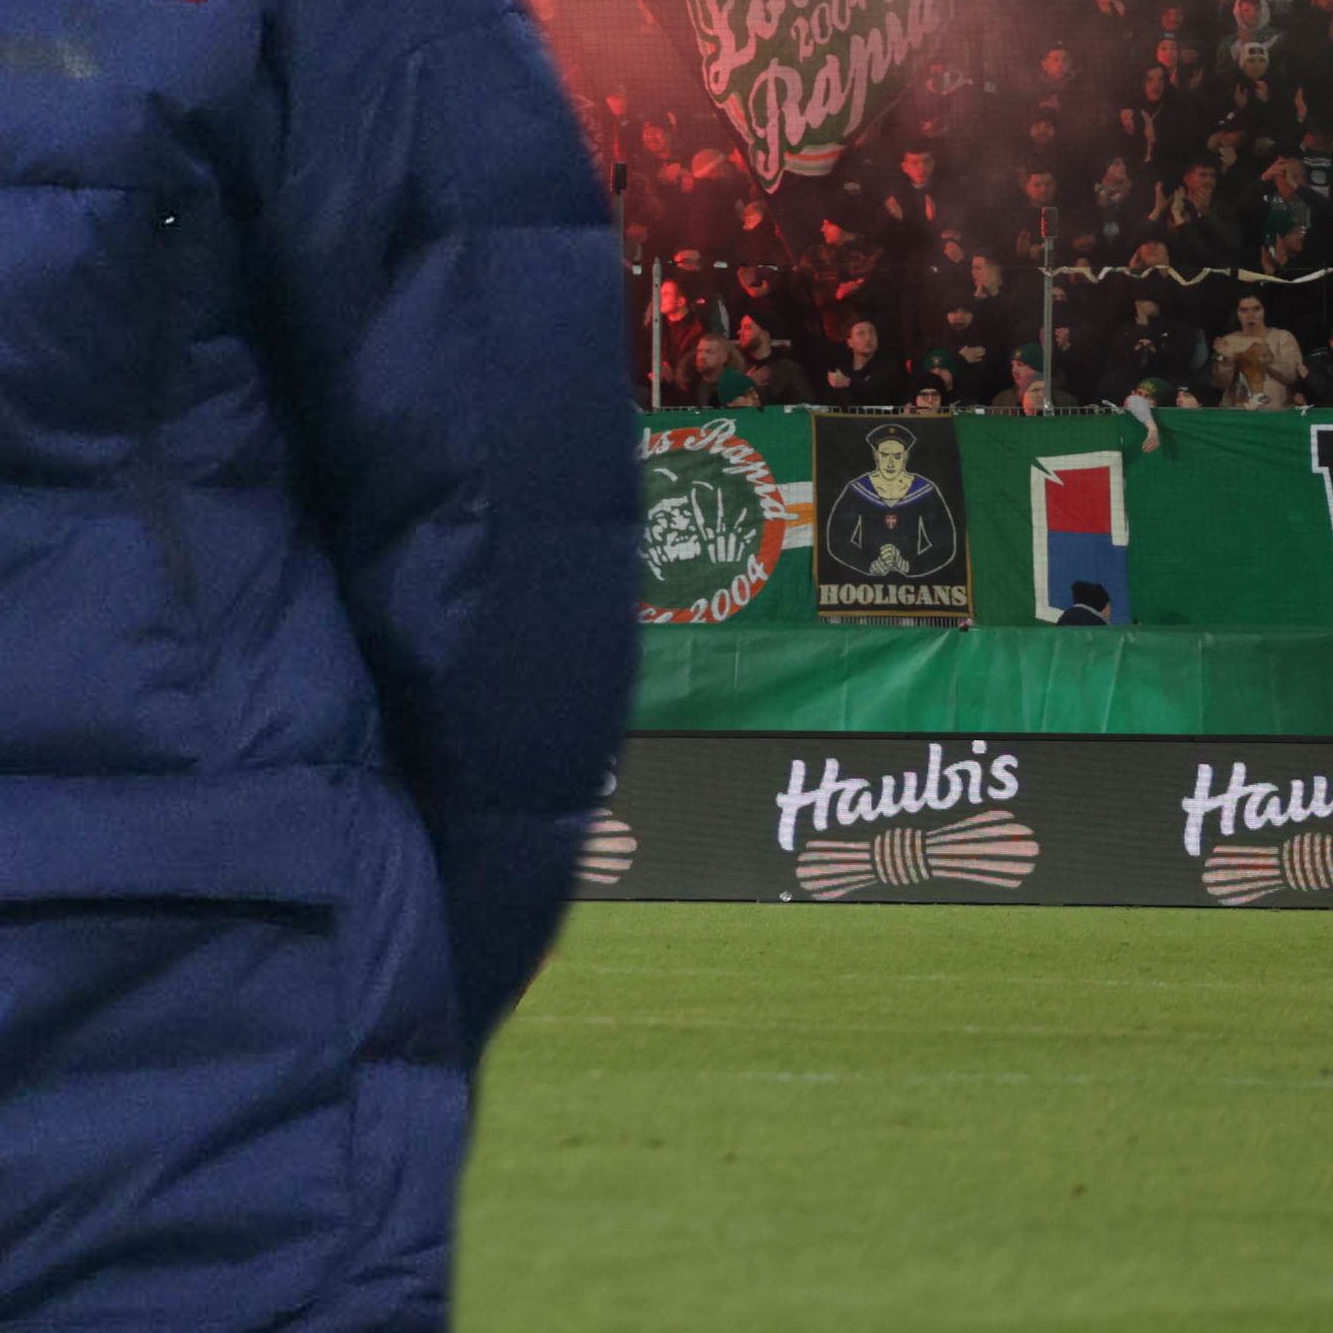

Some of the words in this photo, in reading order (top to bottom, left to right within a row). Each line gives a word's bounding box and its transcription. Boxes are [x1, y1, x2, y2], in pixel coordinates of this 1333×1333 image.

[683, 417, 800, 521] Rapid
[689, 553, 769, 624] 2004
[818, 583, 968, 608] HOOLIGANS
[776, 740, 1019, 851] Haubis
[1181, 761, 1333, 857] Hau
